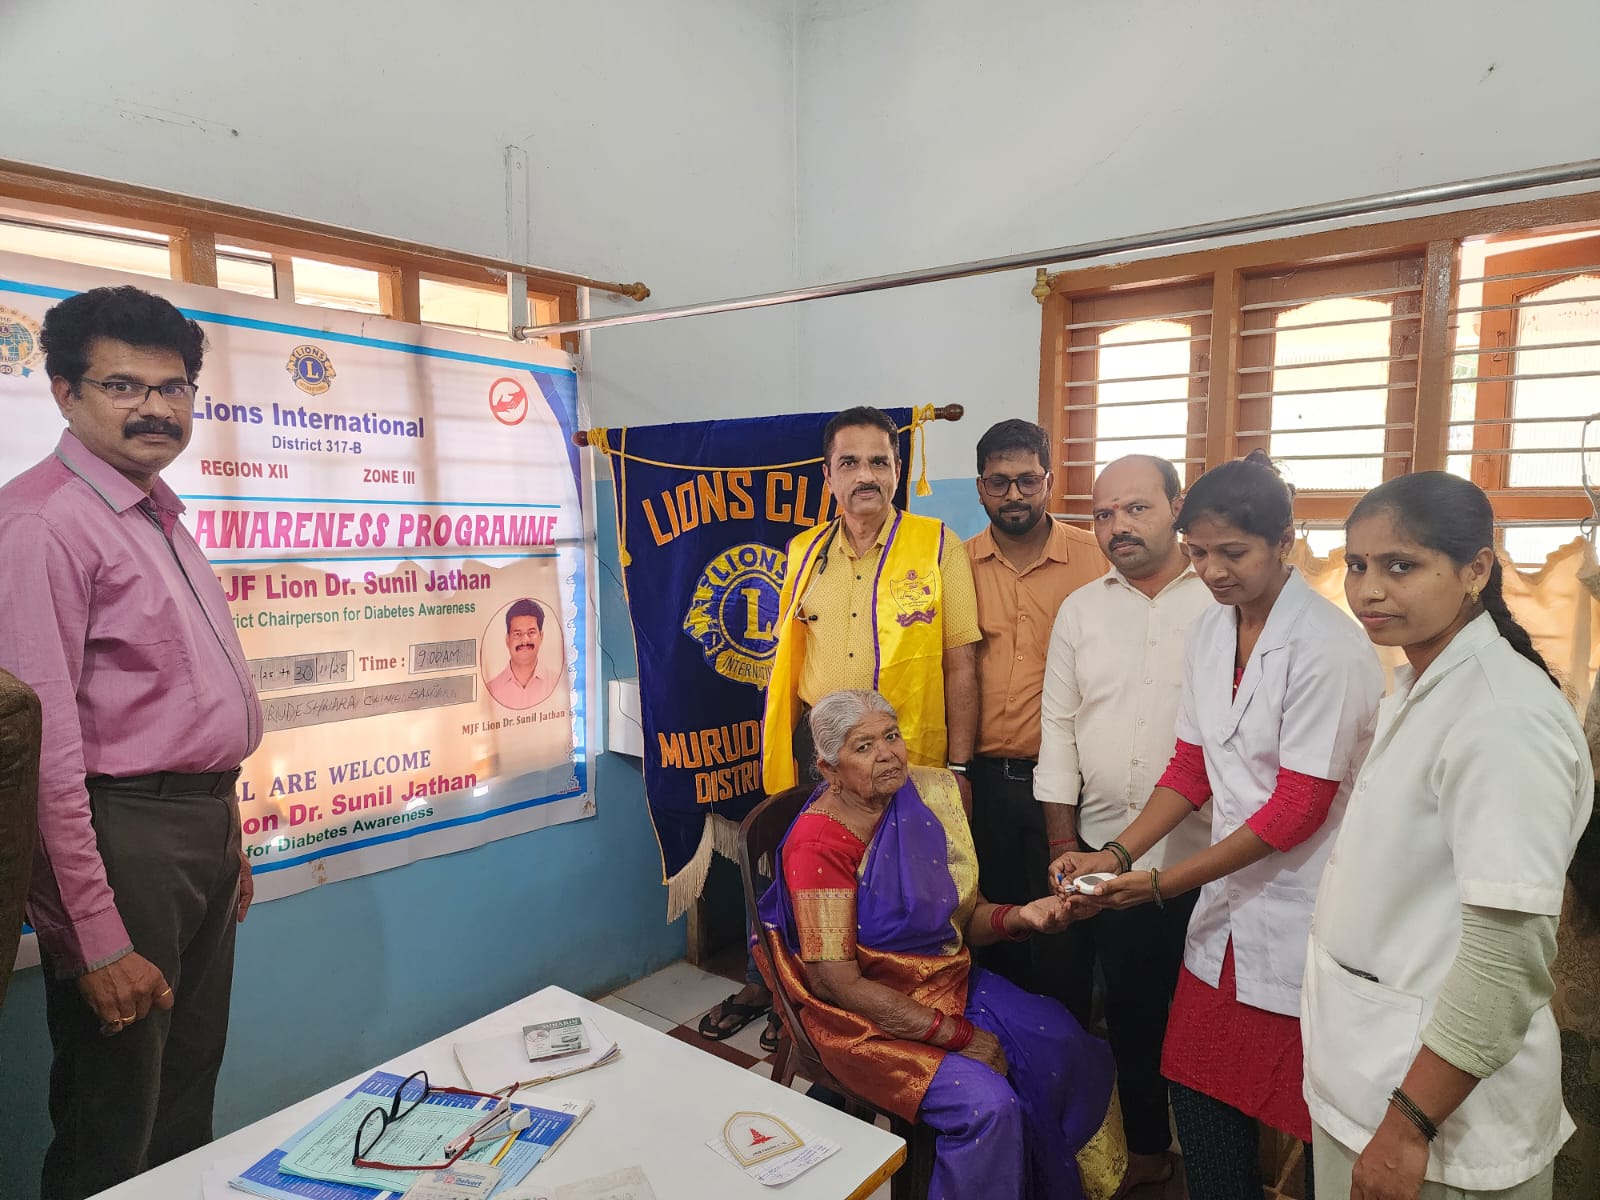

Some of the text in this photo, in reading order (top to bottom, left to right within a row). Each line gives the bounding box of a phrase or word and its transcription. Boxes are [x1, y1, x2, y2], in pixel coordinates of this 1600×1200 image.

[296, 346, 325, 360] LIONS
[273, 402, 425, 438] International
[272, 436, 362, 454] District 317-B
[200, 460, 288, 479] REGION XII
[363, 469, 415, 485] ZONE III
[641, 471, 755, 547] LIONS
[195, 510, 558, 549] AWARENESS PROGRAMME
[265, 573, 318, 600] Lion
[325, 573, 355, 598] Dr.
[363, 571, 418, 596] Sunil
[425, 569, 491, 592] Jathan
[258, 609, 339, 629] Chairperson
[344, 605, 361, 620] for
[364, 604, 415, 620] Diabetes
[418, 601, 476, 617] Awareness
[741, 588, 774, 641] L
[462, 710, 565, 736] MJF Lion Dr. Sunil Jathan
[658, 719, 763, 768] MURUD
[269, 770, 317, 797] ARE
[329, 750, 431, 785] WELCOME
[695, 760, 759, 804] DISTRI
[289, 804, 323, 827] Dr.
[332, 785, 392, 816] Sunil
[401, 773, 477, 801] Jathan
[246, 807, 434, 858] for Diabetes Awareness
